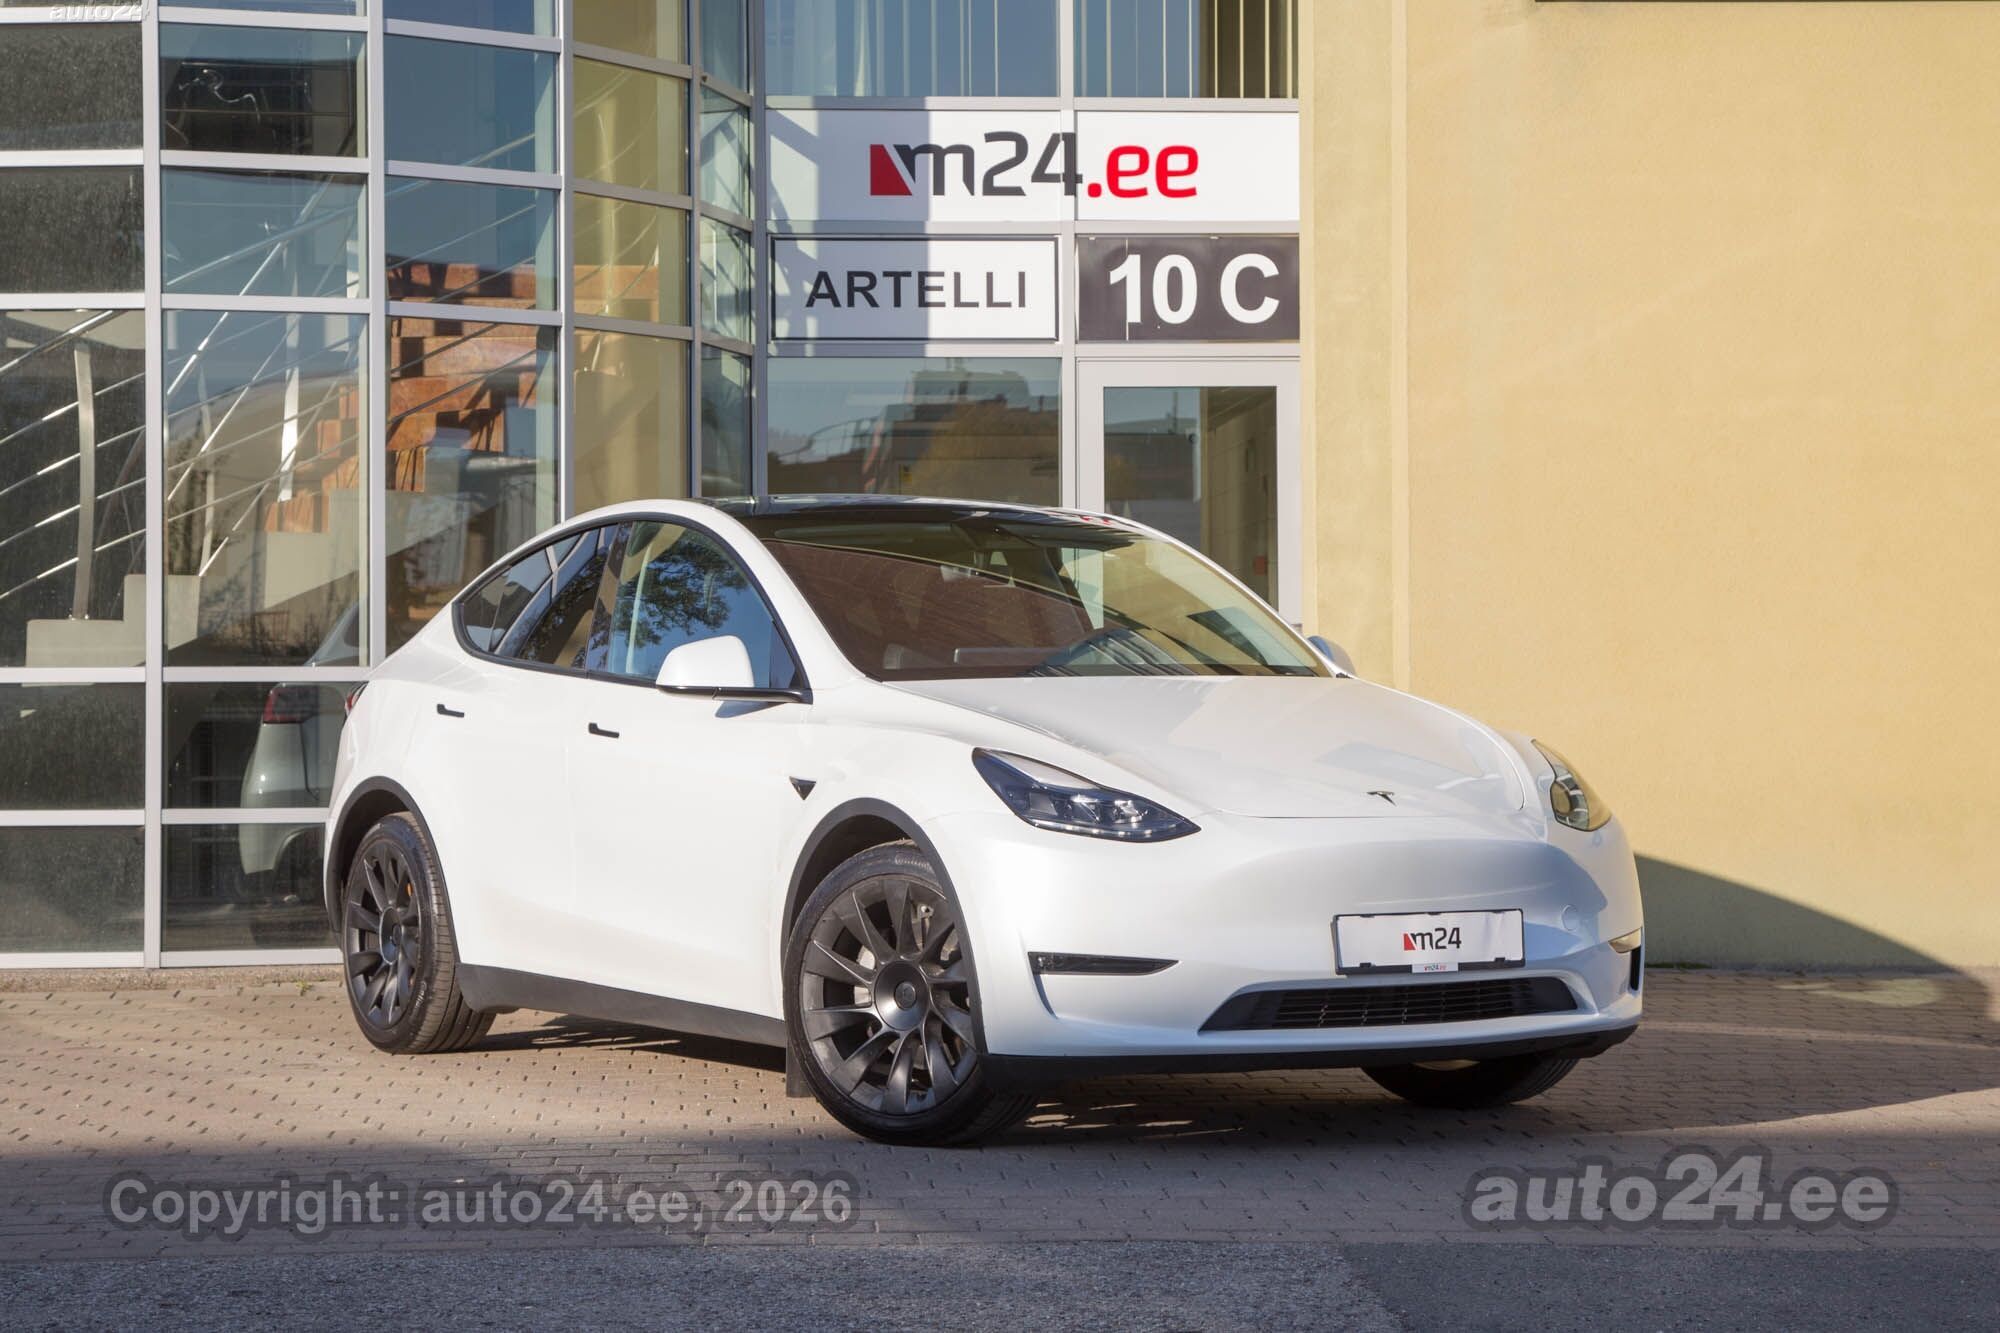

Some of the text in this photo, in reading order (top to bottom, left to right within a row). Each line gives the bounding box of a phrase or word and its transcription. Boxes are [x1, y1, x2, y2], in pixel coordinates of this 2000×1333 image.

[891, 131, 1199, 198] m24.ee
[805, 270, 1026, 308] ARTELLI
[1109, 253, 1280, 325] 10 C
[1411, 927, 1461, 950] m24
